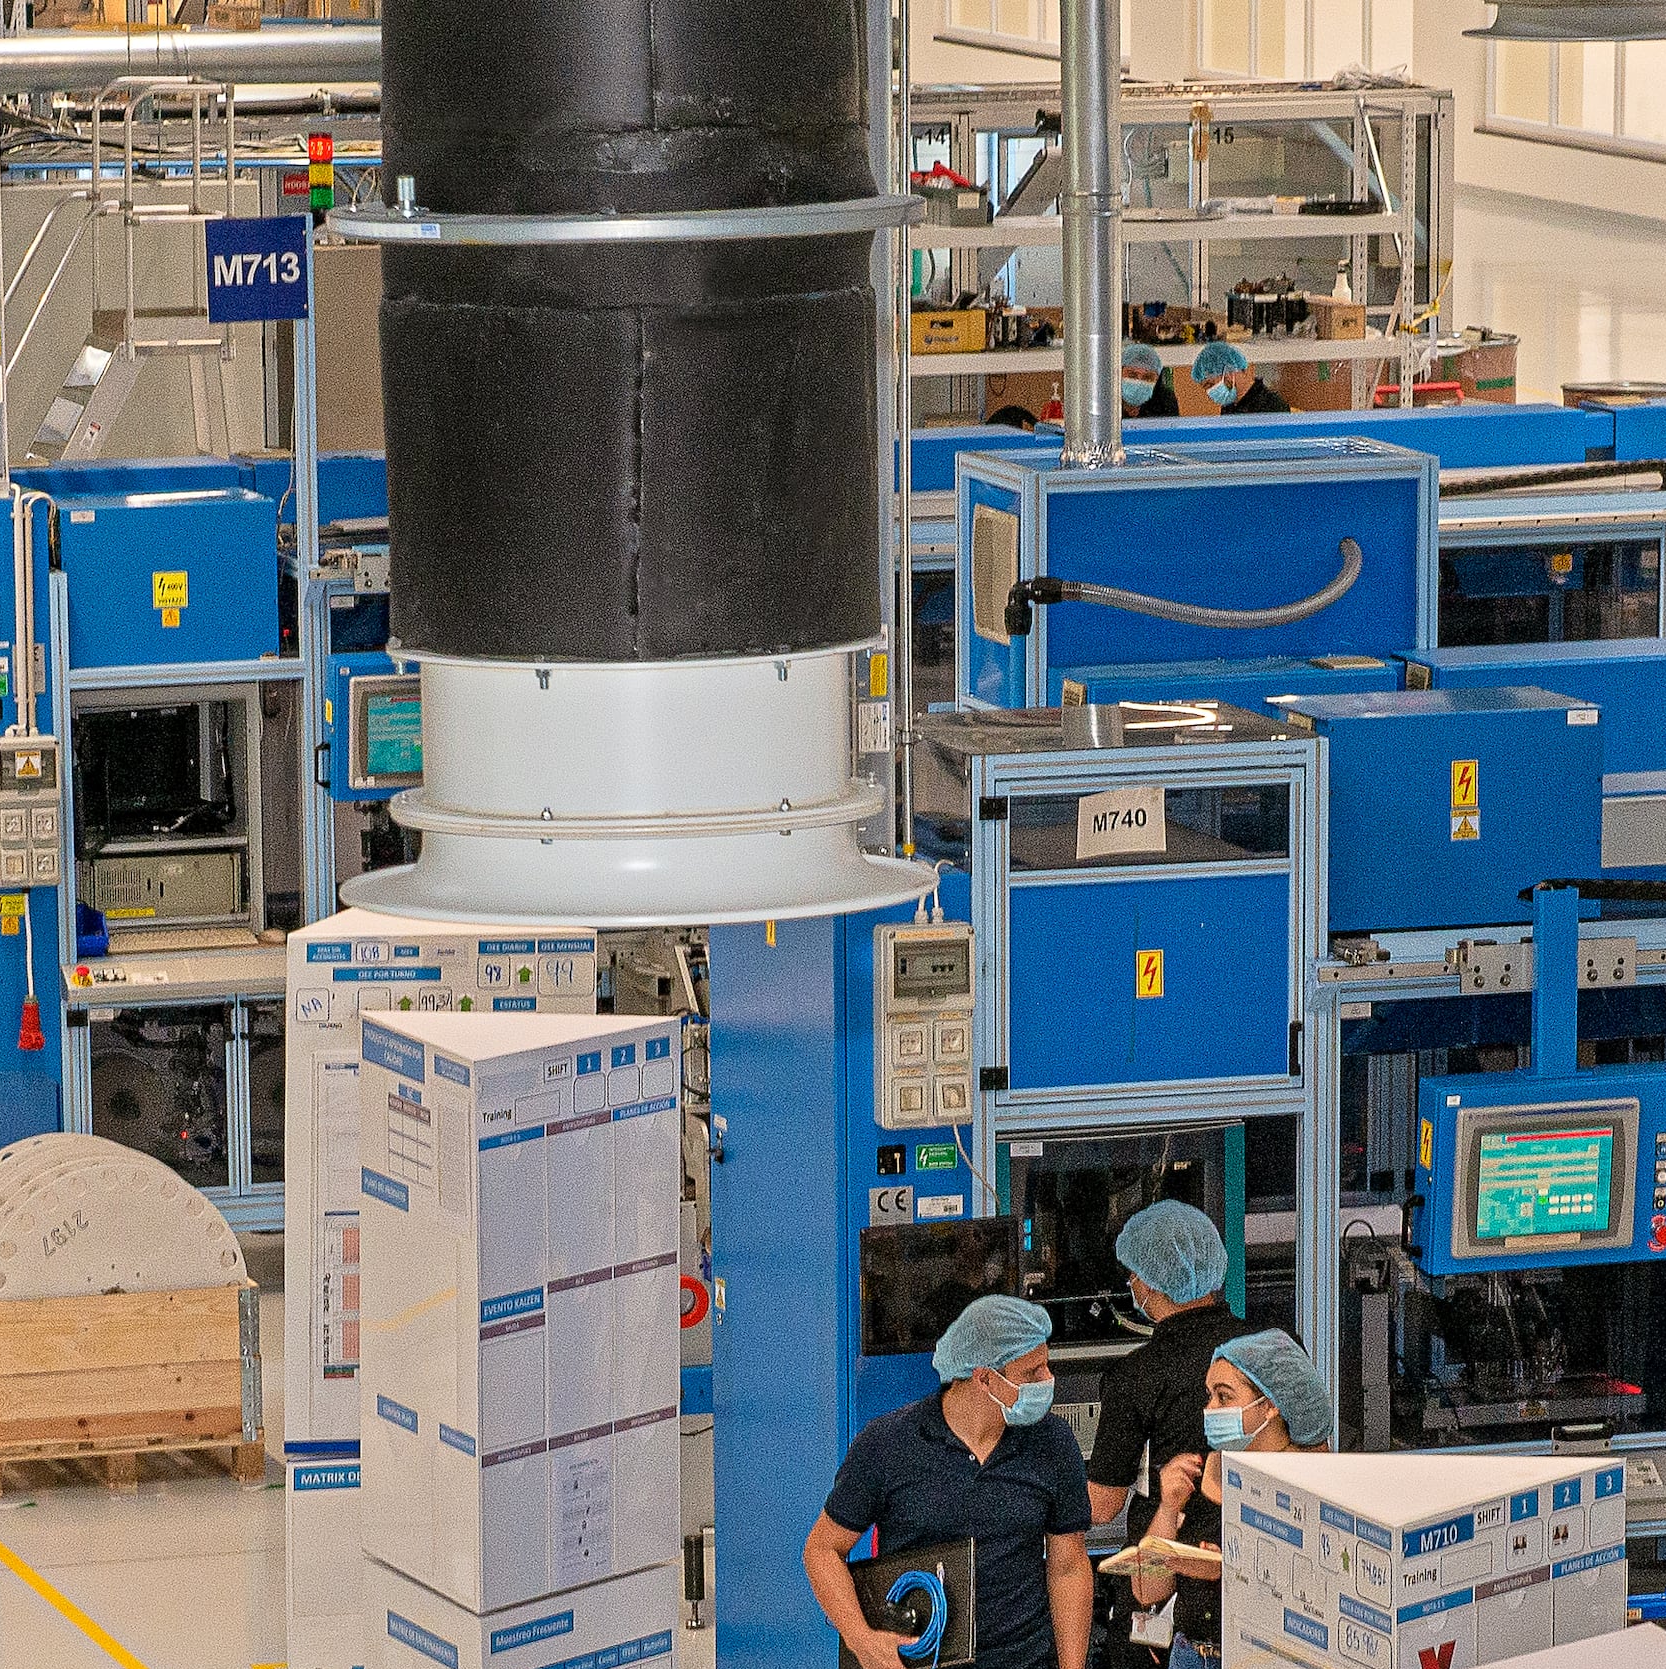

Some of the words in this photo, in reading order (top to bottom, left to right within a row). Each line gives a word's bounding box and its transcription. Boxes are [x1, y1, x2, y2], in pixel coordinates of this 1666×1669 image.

[925, 128, 945, 145] 14
[1213, 127, 1234, 145] 15
[213, 252, 301, 287] M713
[1093, 807, 1147, 833] M740
[486, 942, 500, 952] OEE
[501, 943, 527, 952] DIARIO
[540, 942, 554, 951] OEE
[555, 941, 592, 952] MENSUAL
[390, 970, 416, 979] TURNO
[484, 963, 502, 984] 98
[620, 1051, 626, 1062] 2
[654, 1044, 660, 1055] 3
[547, 1062, 568, 1077] SHIFT
[587, 1058, 592, 1069] 1
[483, 1107, 512, 1124] Training
[878, 1189, 906, 1213] CE
[484, 1301, 513, 1317] EVENTO
[514, 1294, 541, 1309] KAIZEN
[301, 1472, 346, 1486] MATRIX
[1606, 1475, 1613, 1490] 3
[1563, 1486, 1570, 1503] 2
[1294, 1506, 1302, 1521] 26
[1521, 1498, 1528, 1514] 1
[1477, 1506, 1501, 1526] SHIFT
[1420, 1524, 1459, 1553] M710
[1561, 1559, 1585, 1575] PLANES
[1586, 1556, 1594, 1569] DE
[1595, 1549, 1619, 1566] ACCIÓN
[1403, 1567, 1437, 1588] Training
[495, 1626, 532, 1647] Muestreo
[533, 1617, 569, 1638] Frecuente
[1287, 1615, 1325, 1644] INDICADORES
